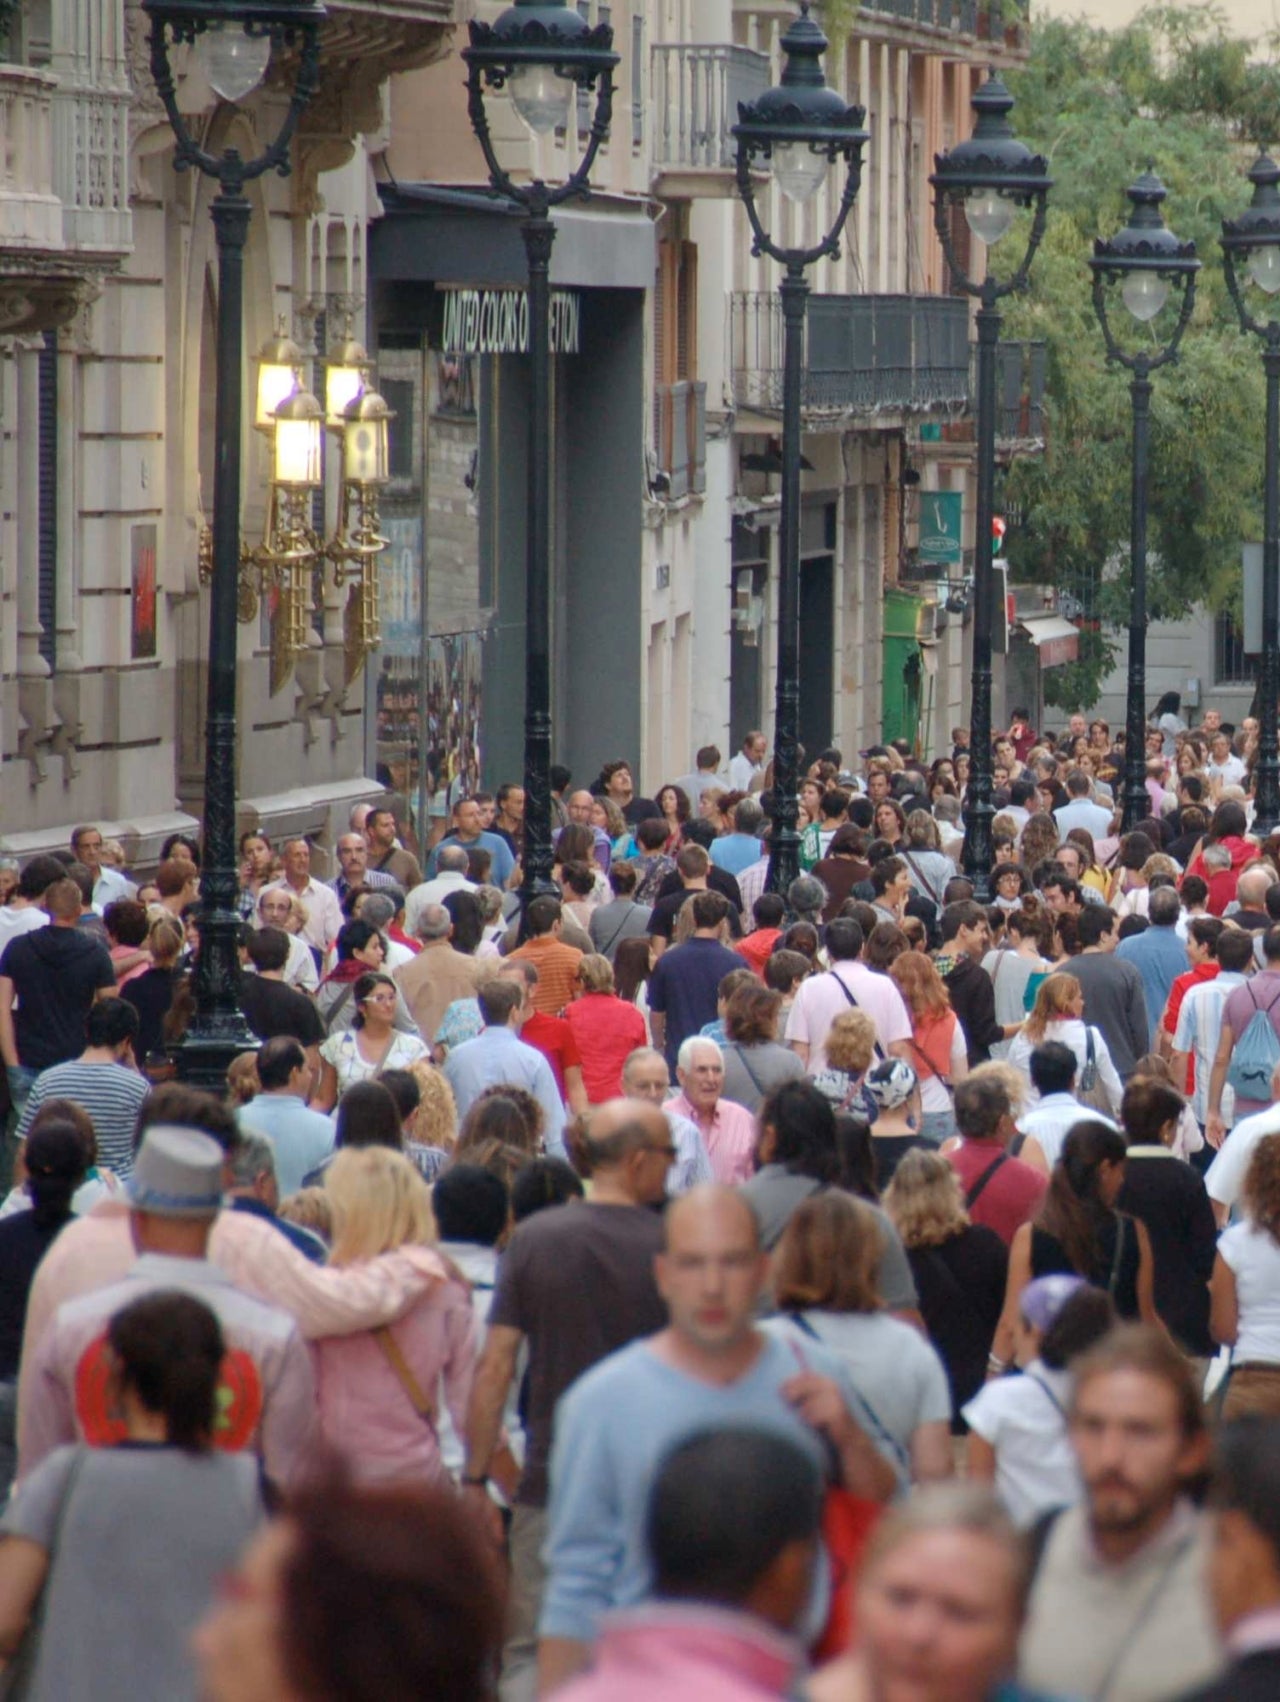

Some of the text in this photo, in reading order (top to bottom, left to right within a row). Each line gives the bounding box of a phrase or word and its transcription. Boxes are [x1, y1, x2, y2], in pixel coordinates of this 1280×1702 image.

[443, 290, 479, 353] UNITED
[480, 290, 516, 353] COLORS
[549, 291, 579, 353] ETTON
